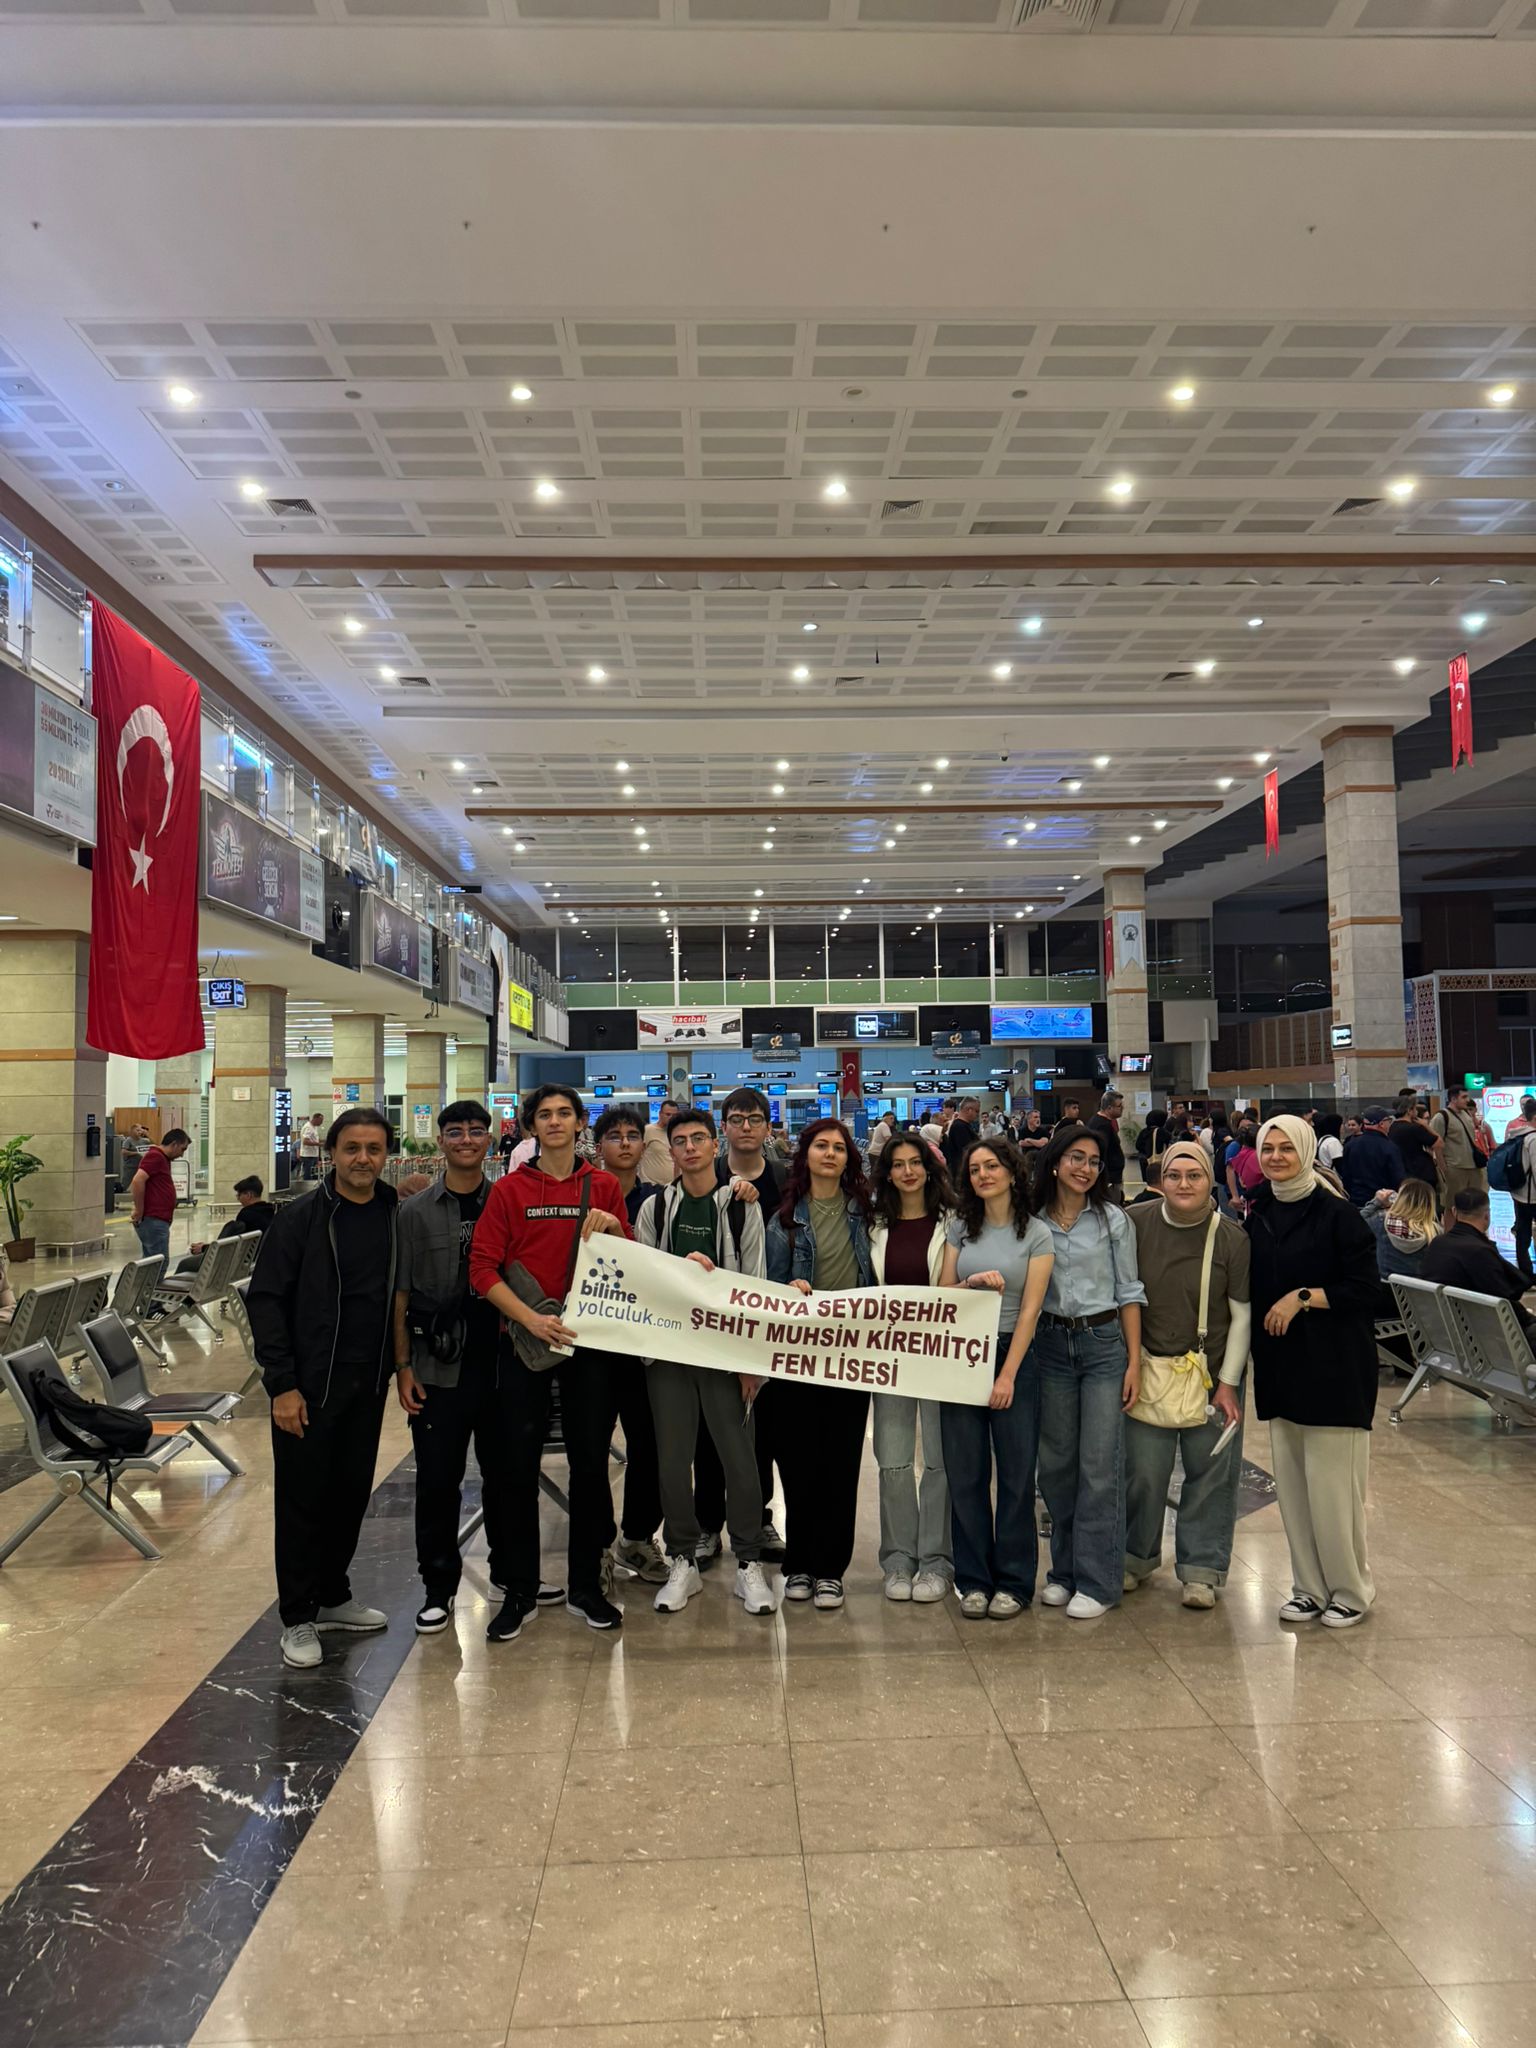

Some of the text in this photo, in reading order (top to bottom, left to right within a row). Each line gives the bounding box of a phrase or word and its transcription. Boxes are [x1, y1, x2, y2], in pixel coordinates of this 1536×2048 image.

[211, 982, 232, 991] ÇIKIŞ
[212, 991, 232, 1000] EXIT
[527, 1207, 590, 1217] CONTEXT UNKNO
[581, 1280, 637, 1304] bilime
[577, 1300, 682, 1330] yolculuk.com
[730, 1288, 957, 1326] KONYA SEYDİŞEHİR
[690, 1308, 989, 1368] ŞEHİT MUHSİN KİREMİTÇİ
[771, 1352, 899, 1387] FEN LİSESİ
